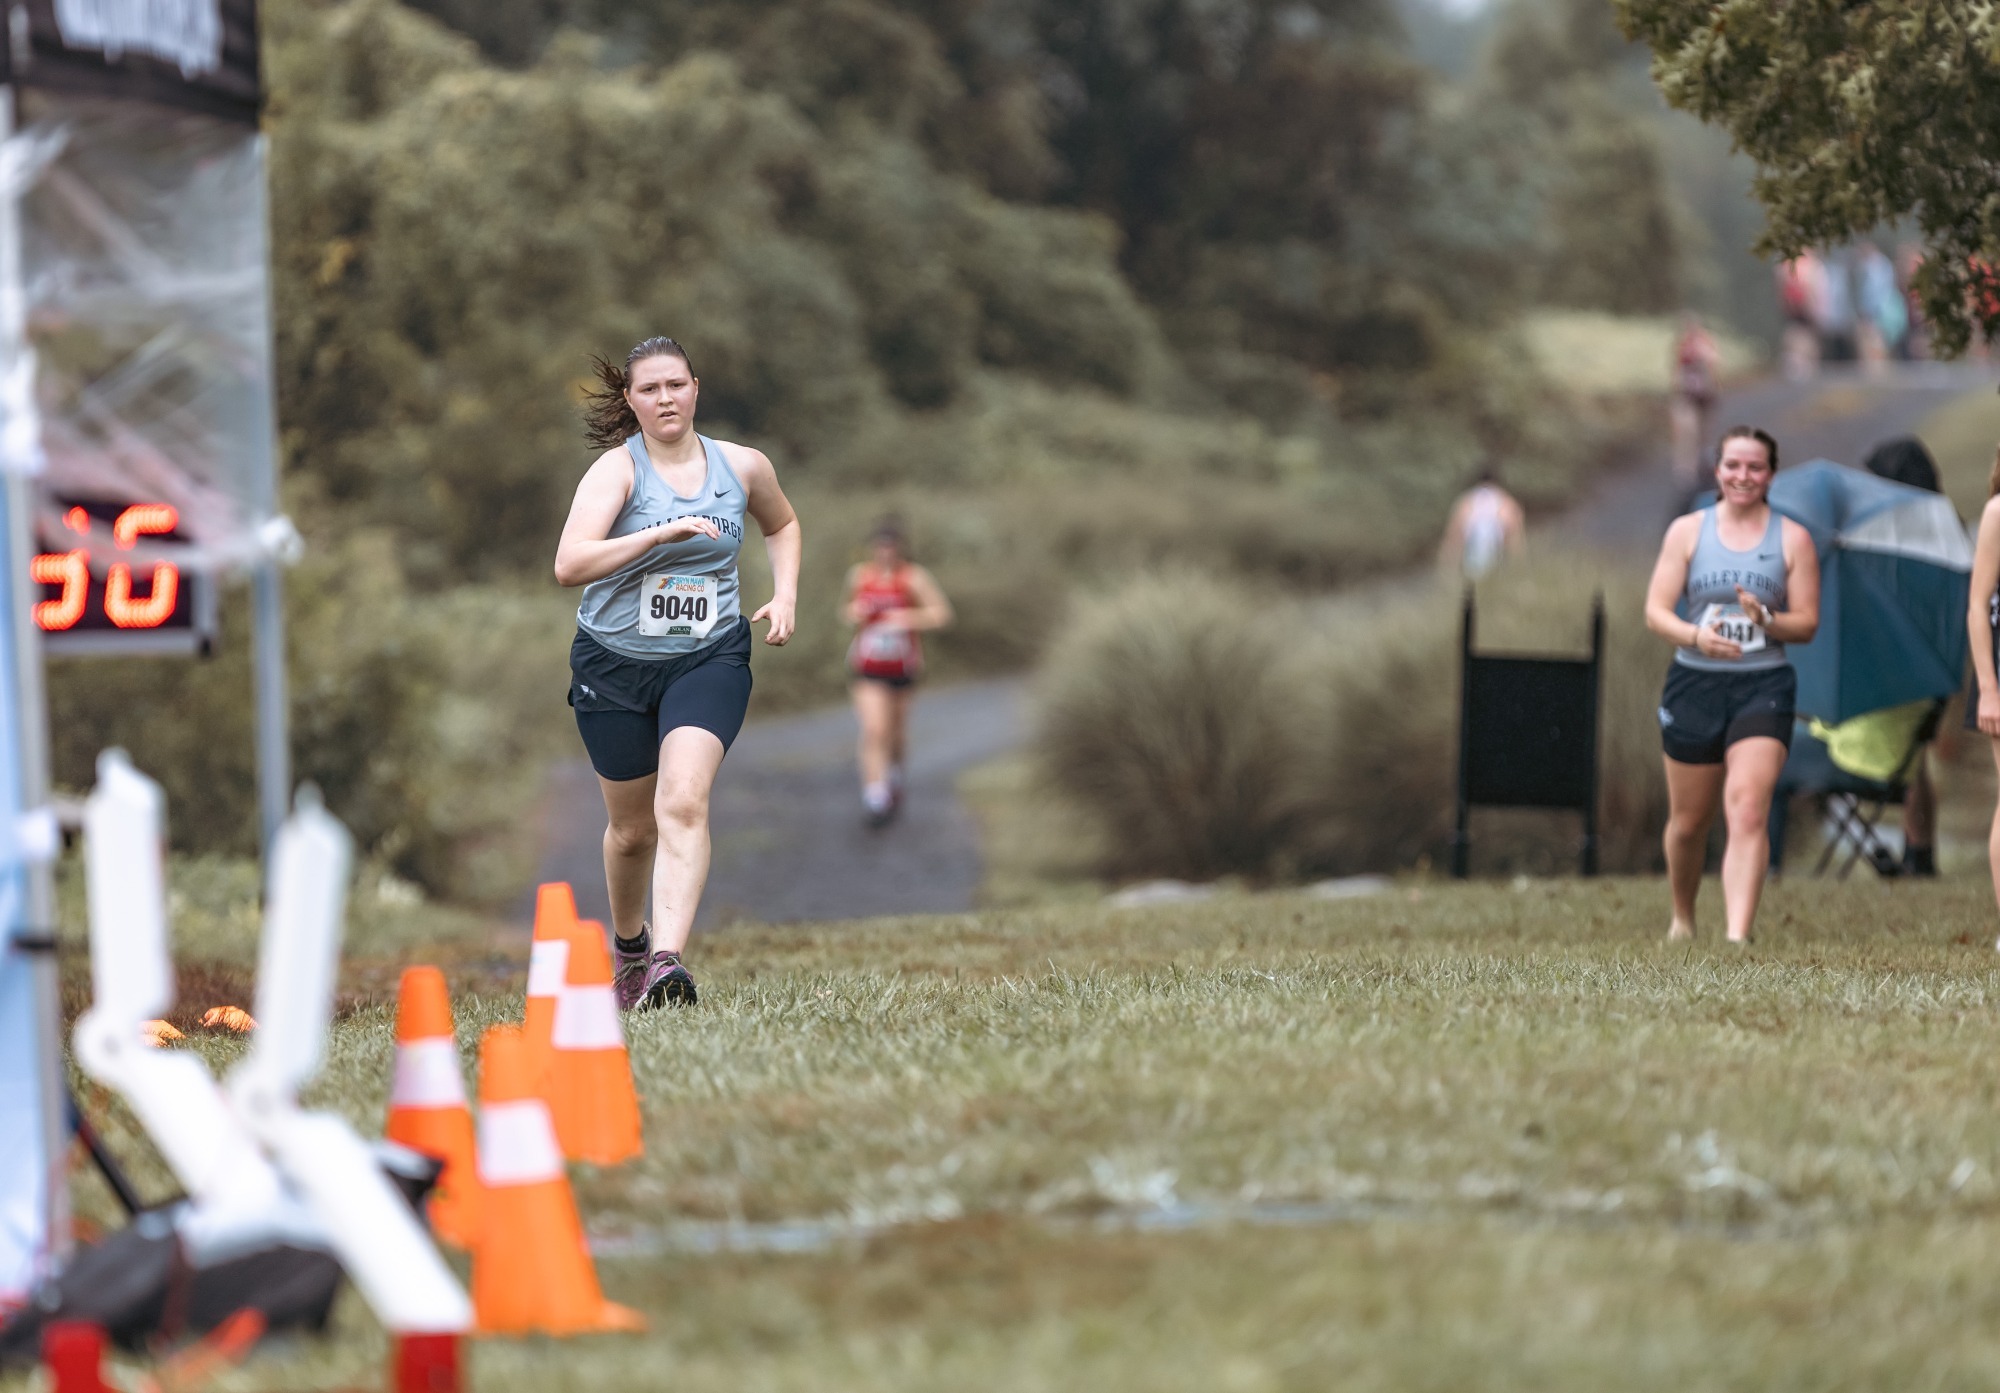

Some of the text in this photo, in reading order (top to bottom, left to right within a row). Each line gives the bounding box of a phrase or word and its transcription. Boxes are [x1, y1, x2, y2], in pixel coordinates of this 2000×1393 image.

[676, 576, 705, 585] BRYN MAWR
[676, 583, 705, 592] RACING CO
[651, 594, 708, 622] 9040
[1709, 619, 1753, 642] 041
